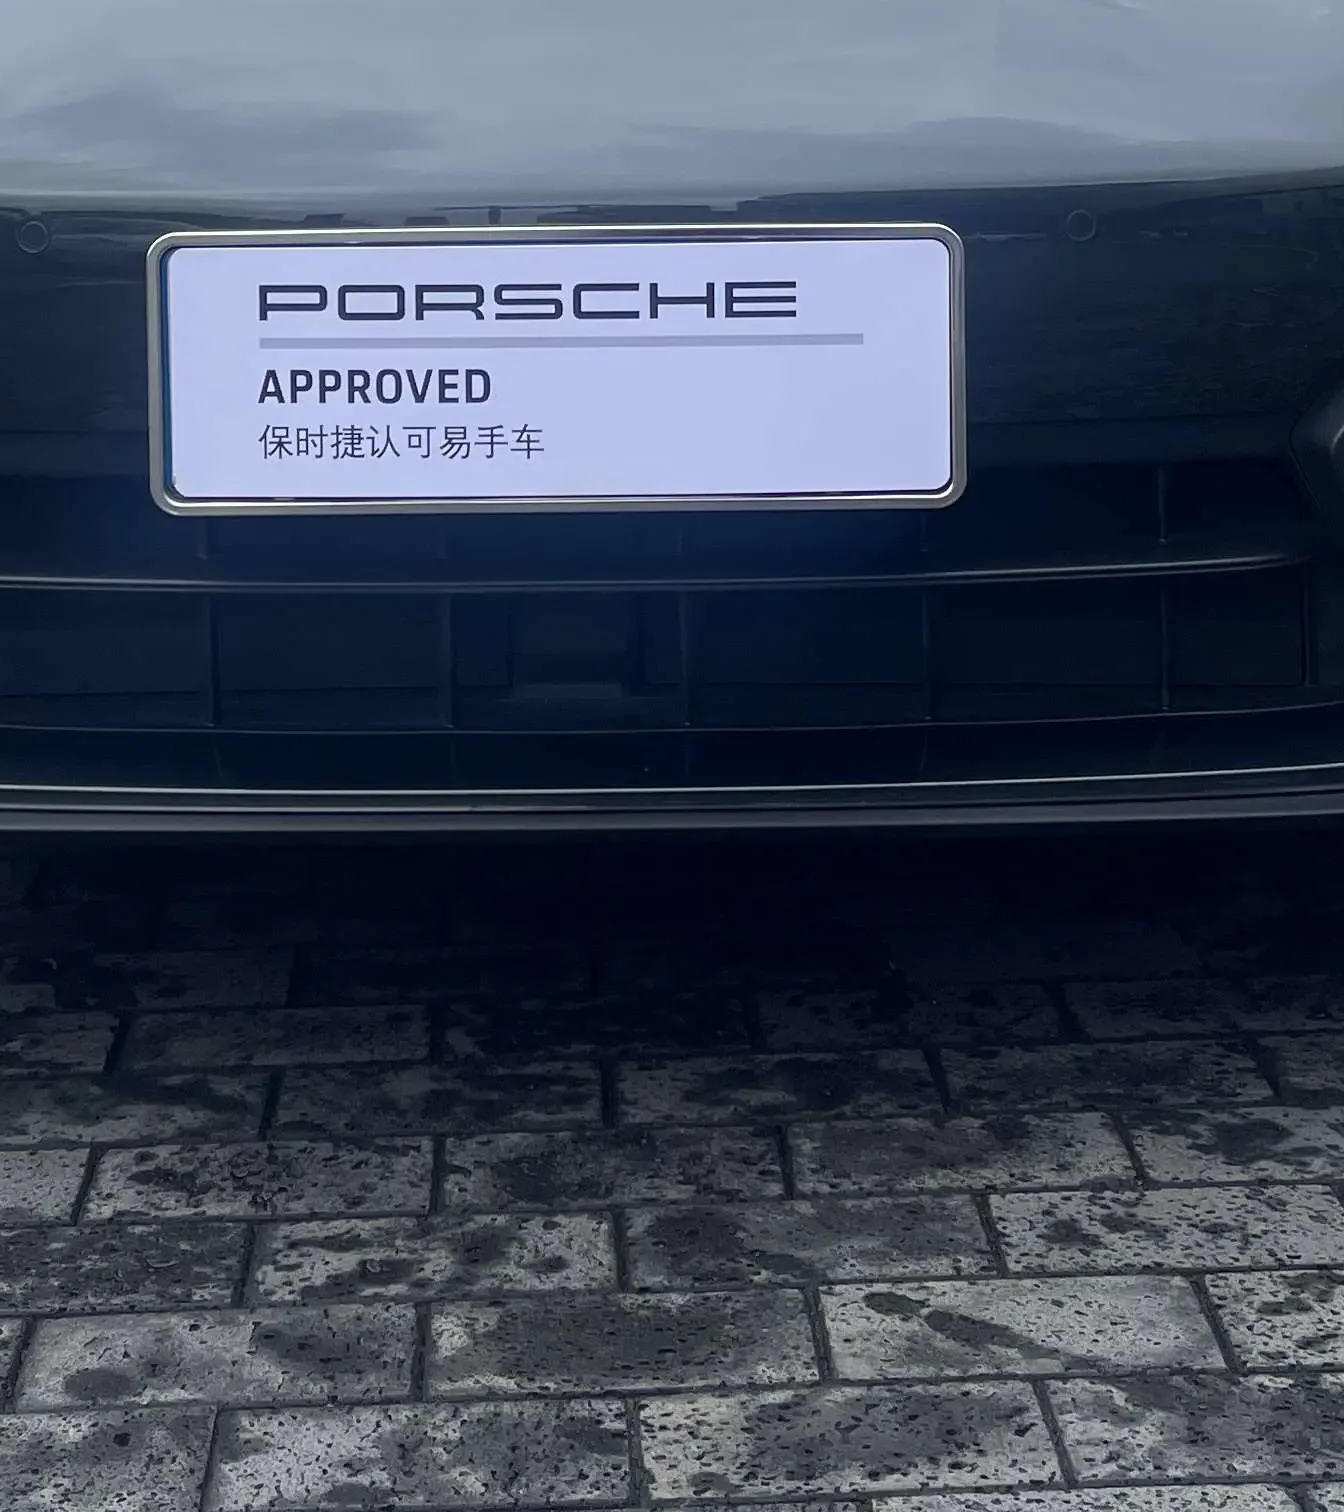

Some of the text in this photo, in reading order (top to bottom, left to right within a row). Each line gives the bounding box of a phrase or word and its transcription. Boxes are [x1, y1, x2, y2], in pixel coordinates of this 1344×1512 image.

[259, 281, 797, 322] PORSCHE
[258, 368, 492, 404] APPROVED
[258, 424, 545, 460] 保时捷认可易手车
